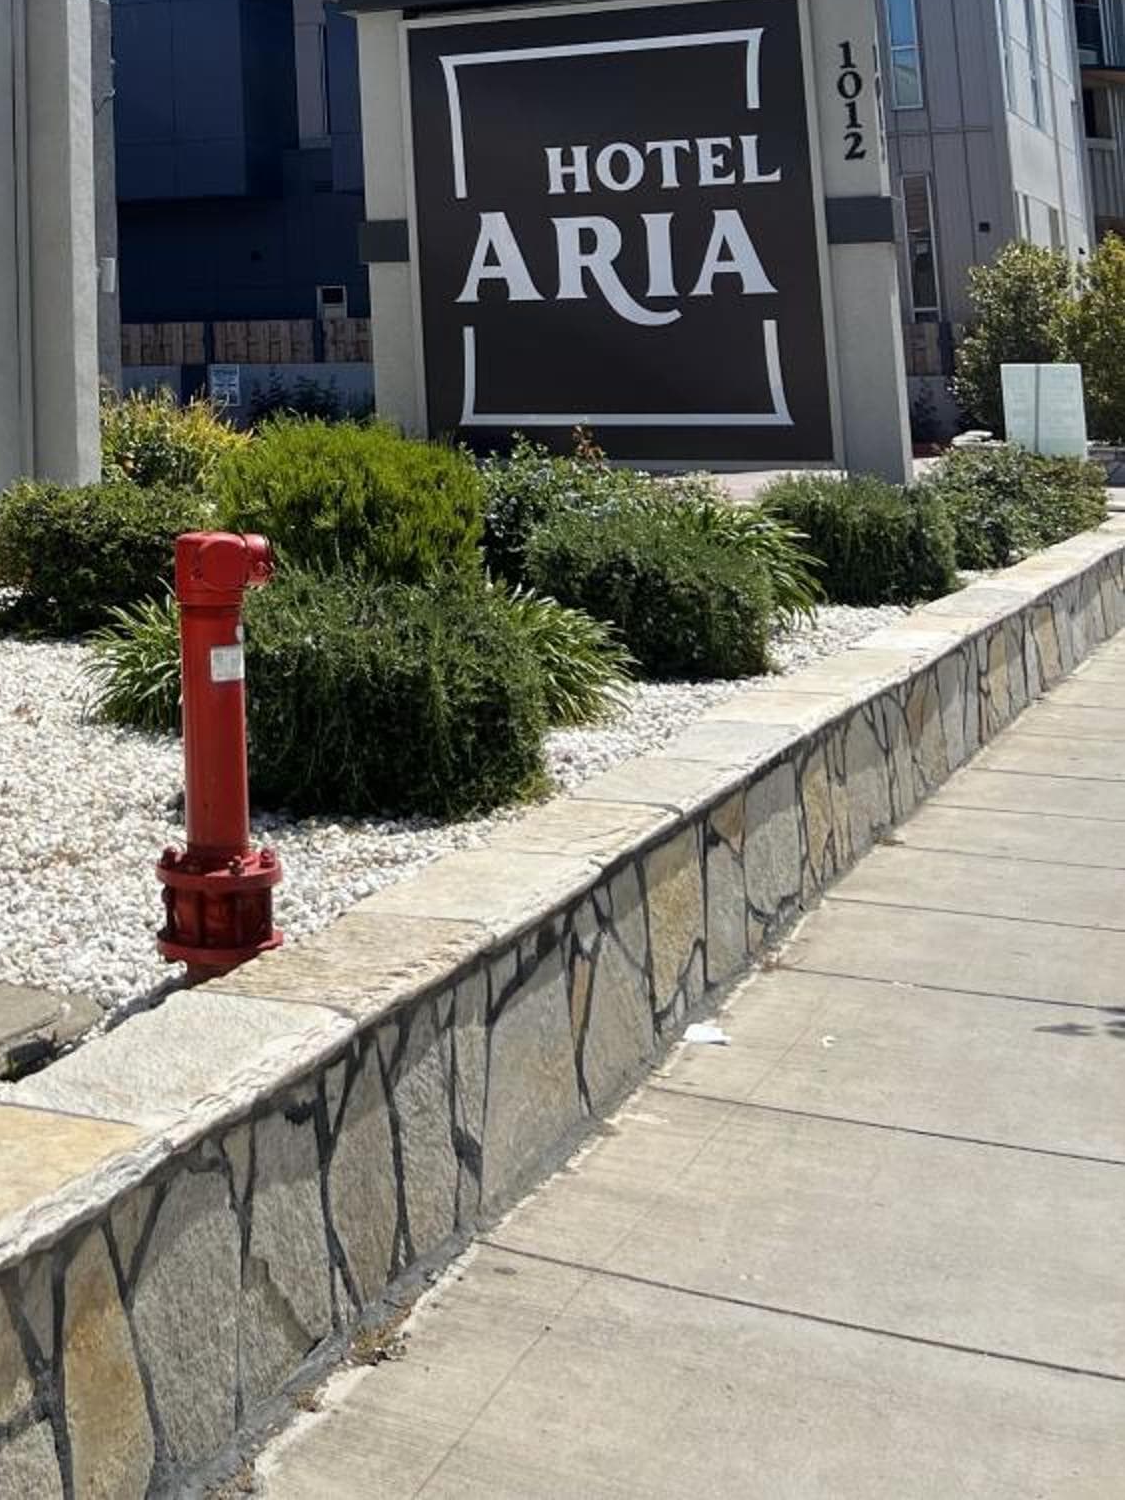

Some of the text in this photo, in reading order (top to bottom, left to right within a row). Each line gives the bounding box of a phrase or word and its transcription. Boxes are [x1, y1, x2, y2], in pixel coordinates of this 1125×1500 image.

[837, 40, 867, 161] 1012
[545, 134, 781, 195] HOTEL
[454, 209, 778, 327] ARIA
